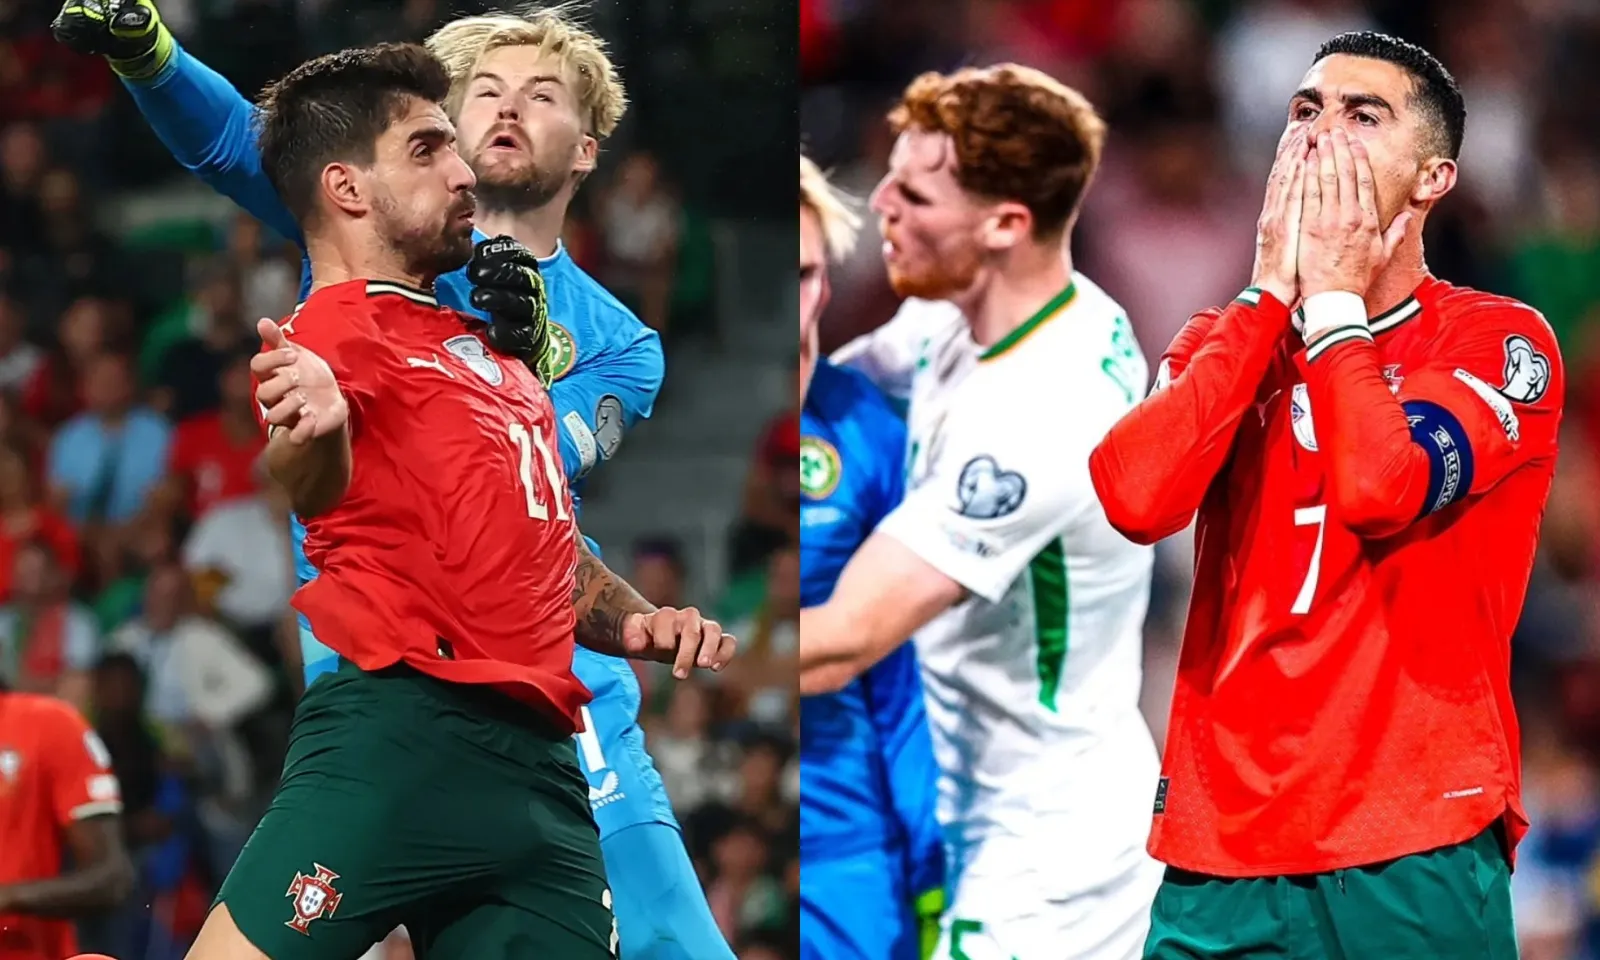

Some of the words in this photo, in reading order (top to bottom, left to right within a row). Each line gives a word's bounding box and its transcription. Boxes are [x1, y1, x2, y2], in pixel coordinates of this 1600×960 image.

[508, 422, 570, 522] 21
[1437, 451, 1458, 511] RESPEC
[1290, 503, 1328, 615] 7
